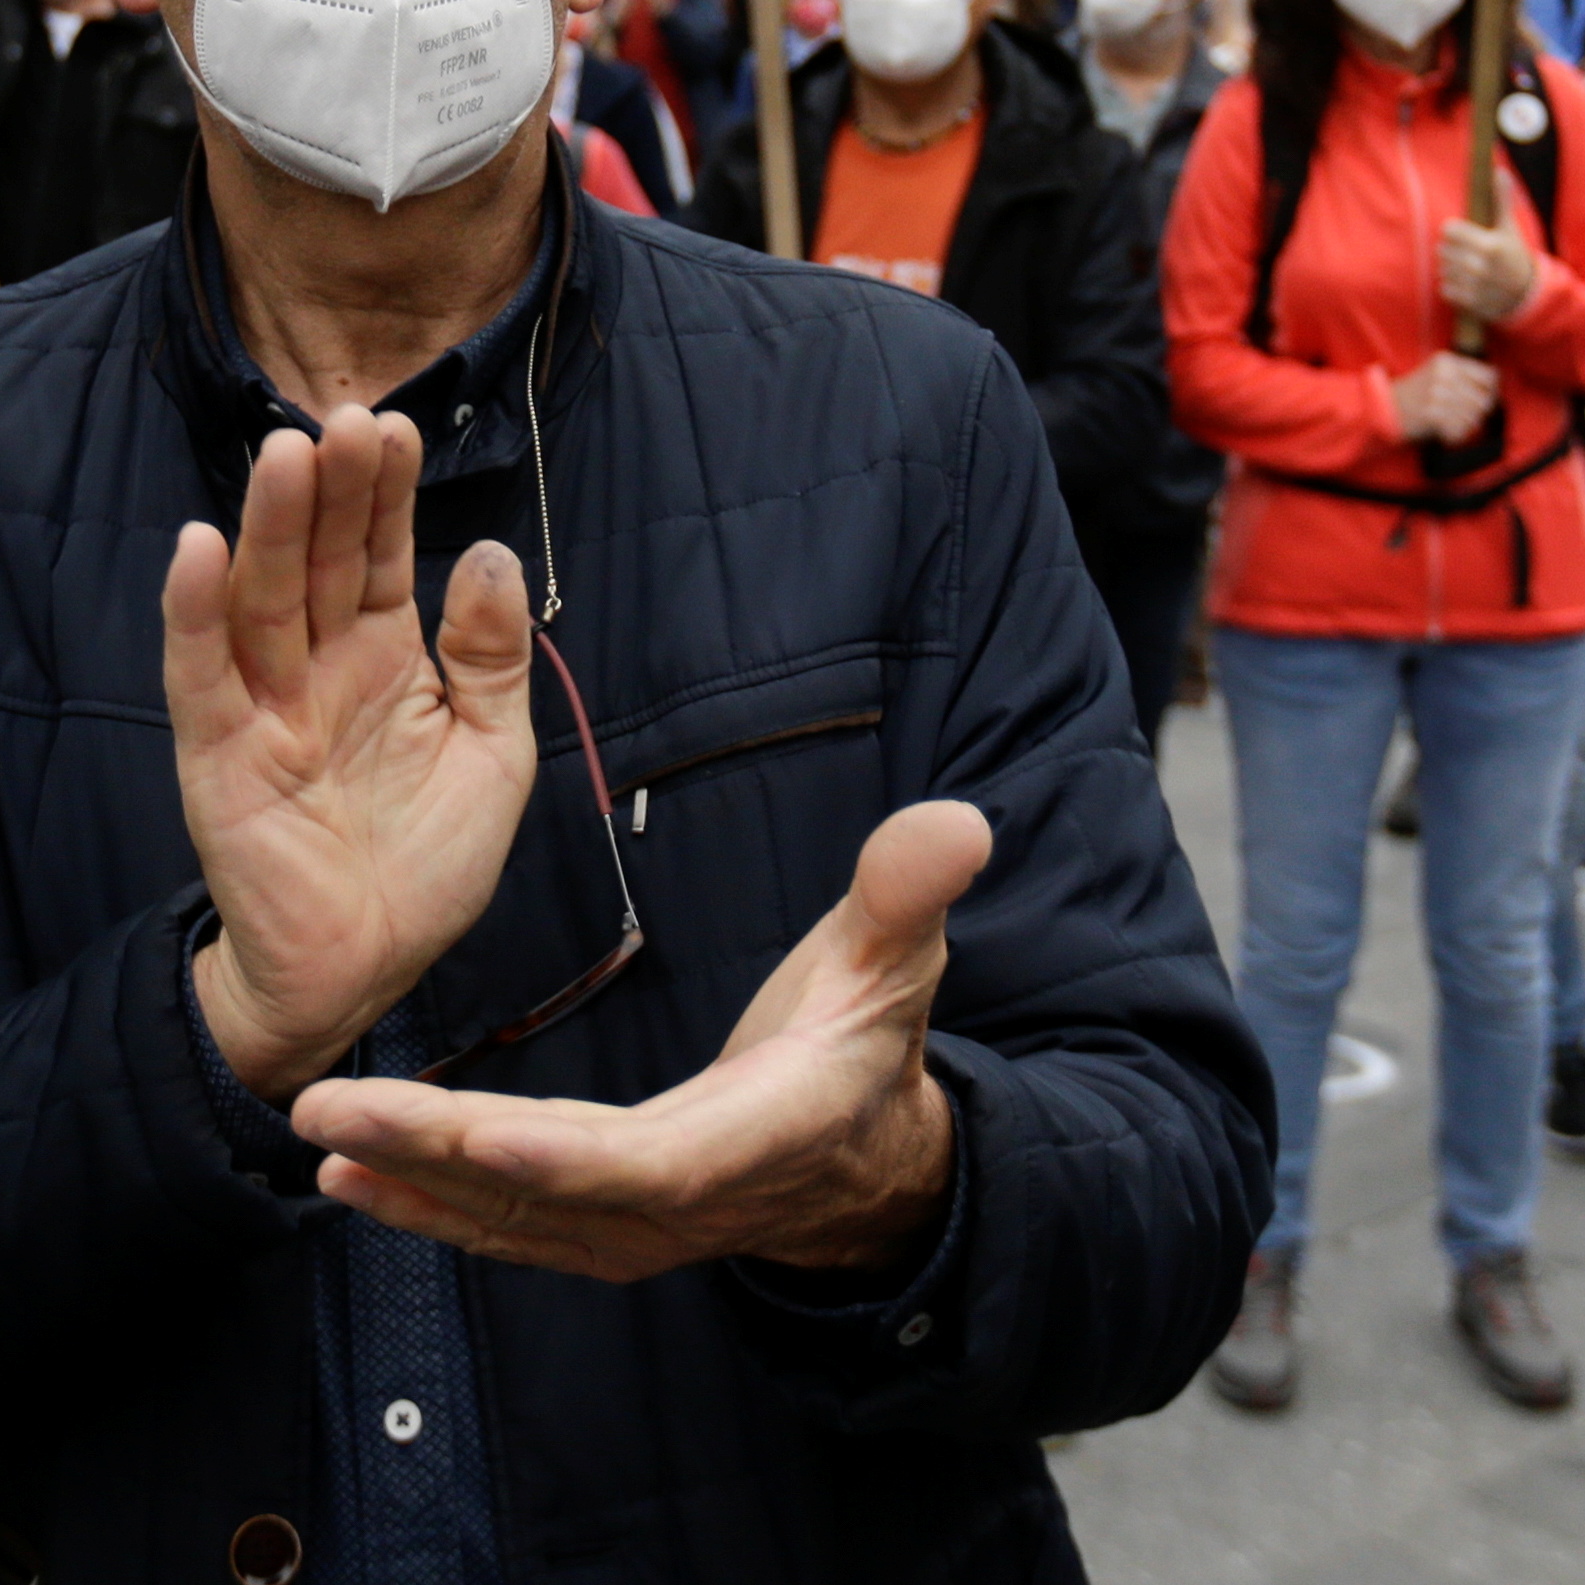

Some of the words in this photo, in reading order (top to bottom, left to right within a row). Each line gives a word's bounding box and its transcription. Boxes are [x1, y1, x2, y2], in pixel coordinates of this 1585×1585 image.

[418, 33, 450, 54] VENUS
[451, 19, 493, 43] VIETNAM
[440, 53, 465, 77] FFP2
[468, 48, 488, 68] NR
[437, 103, 454, 125] CE
